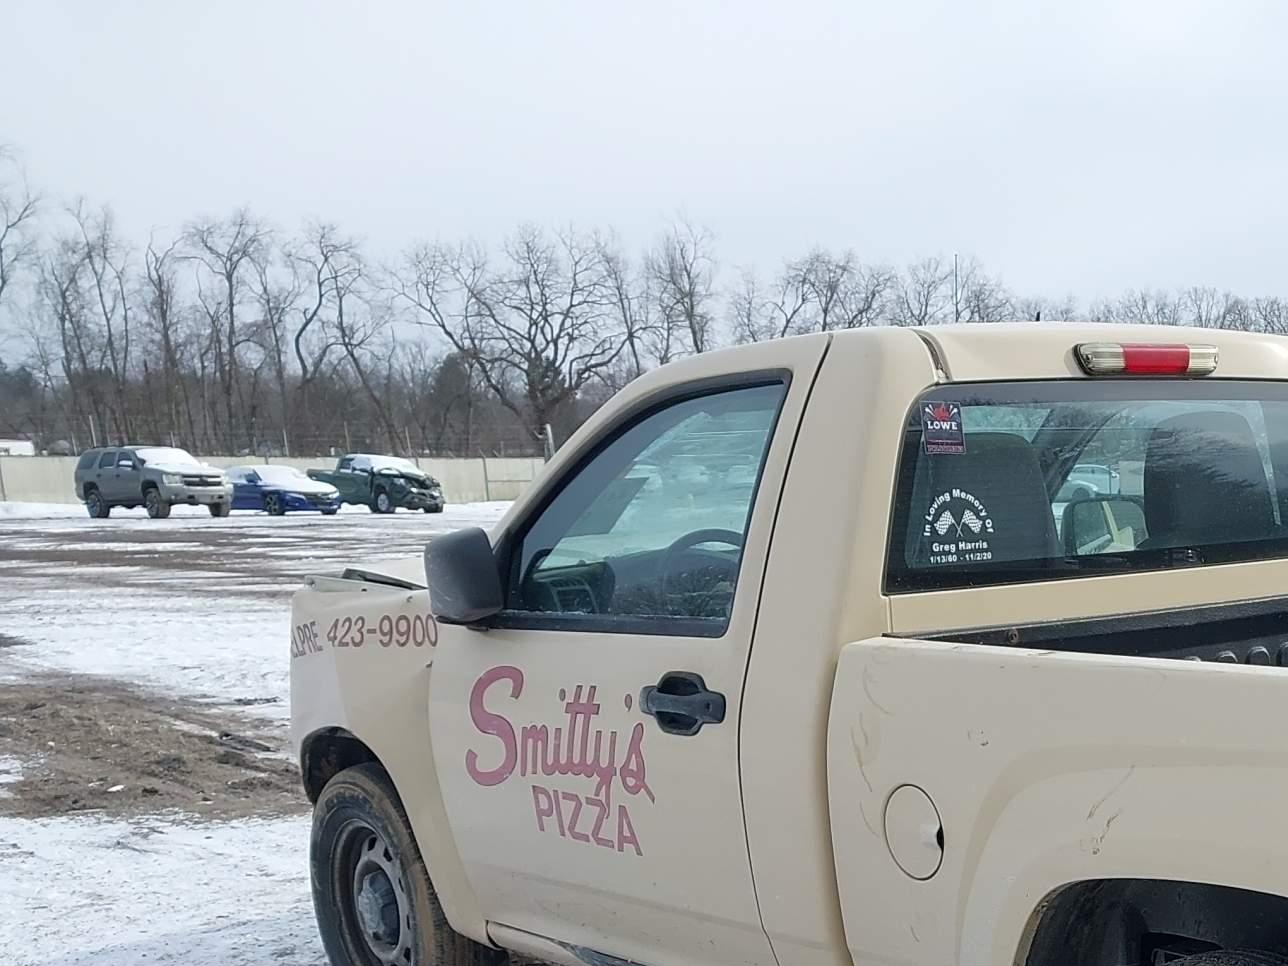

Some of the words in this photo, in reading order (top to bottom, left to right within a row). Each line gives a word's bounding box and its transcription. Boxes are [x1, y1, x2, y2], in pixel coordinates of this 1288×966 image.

[927, 420, 958, 430] LOWE
[925, 492, 951, 522] Loving
[952, 488, 988, 517] Memory
[923, 524, 932, 537] In
[932, 542, 956, 553] Greg
[958, 540, 988, 551] Harris
[326, 614, 438, 648] 423-9900
[465, 665, 655, 819] Smitty's
[532, 784, 644, 856] PIZZA
